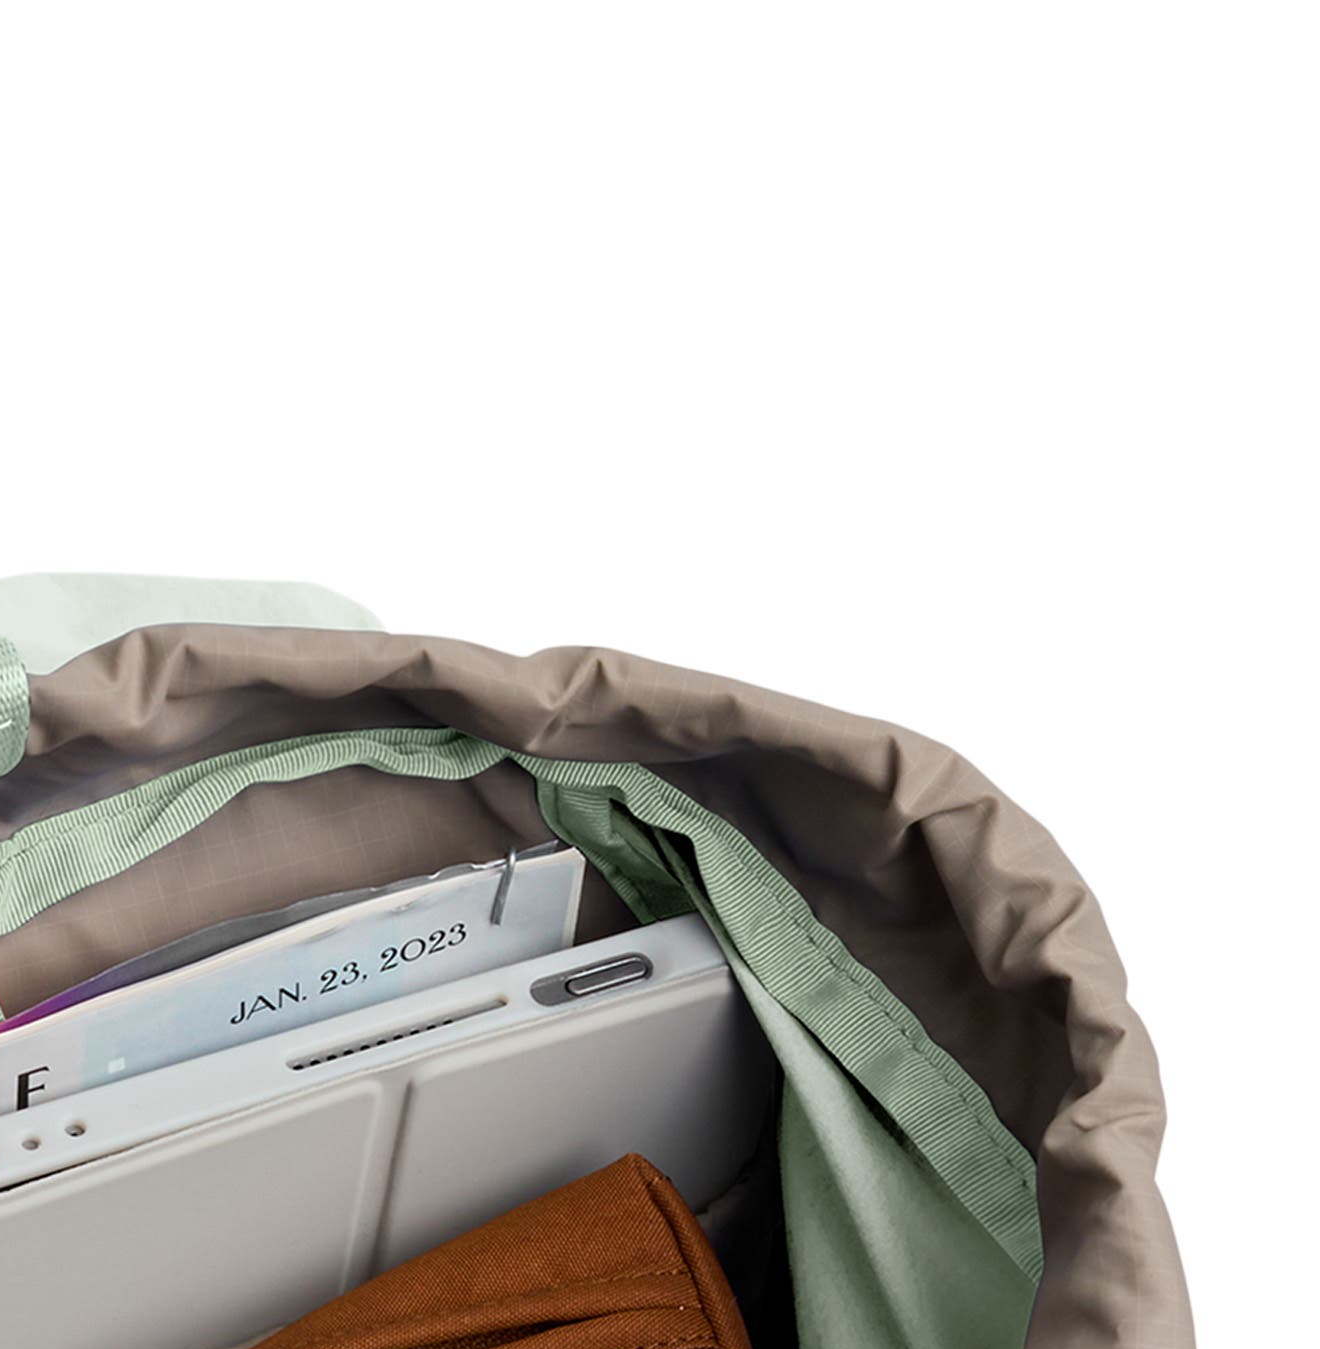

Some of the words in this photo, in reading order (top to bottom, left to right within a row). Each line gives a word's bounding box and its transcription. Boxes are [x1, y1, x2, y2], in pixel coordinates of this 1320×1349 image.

[230, 982, 307, 1024] JAN.
[319, 961, 368, 994] 23,
[379, 922, 467, 973] 2023
